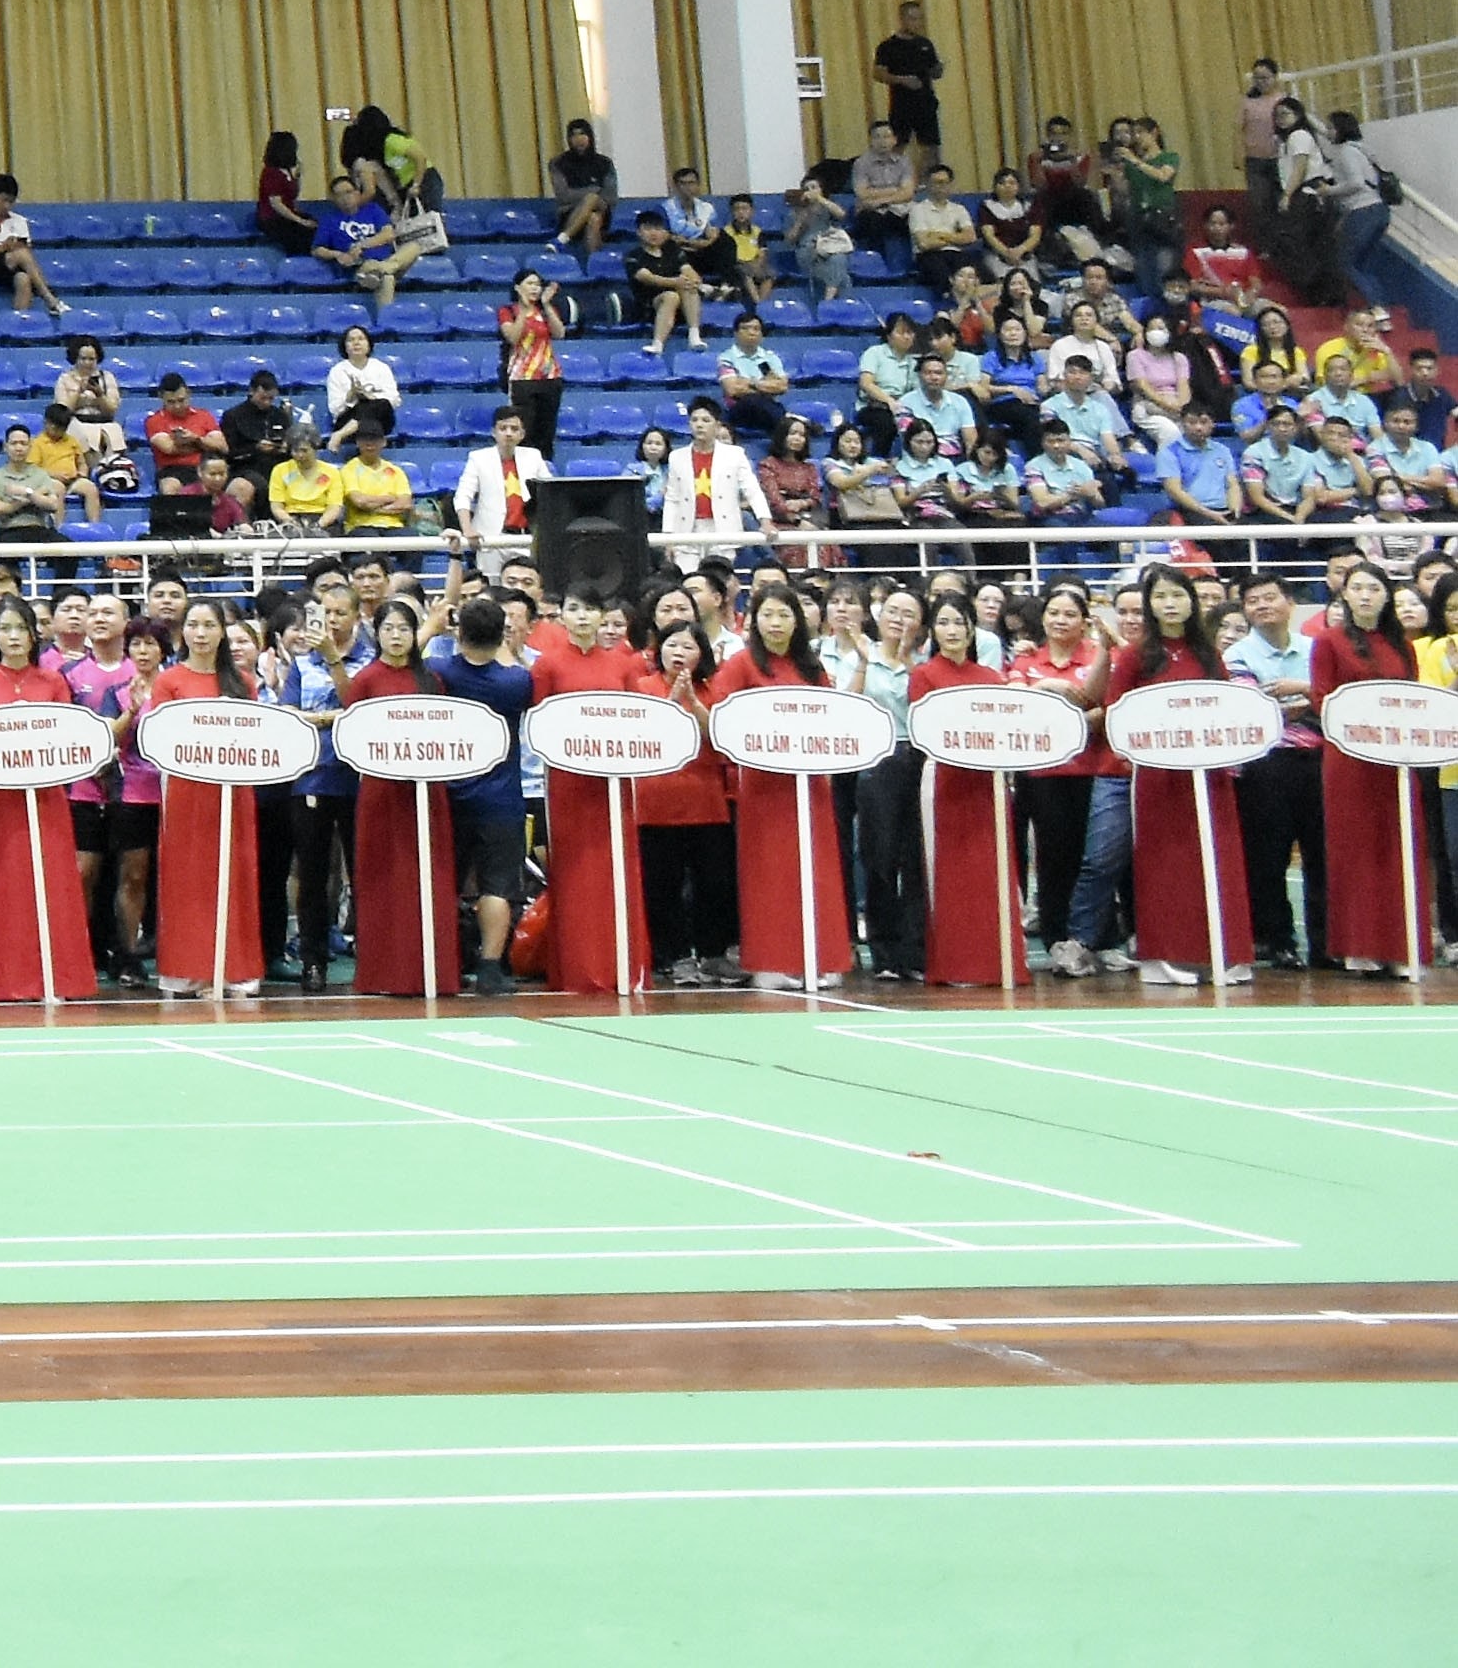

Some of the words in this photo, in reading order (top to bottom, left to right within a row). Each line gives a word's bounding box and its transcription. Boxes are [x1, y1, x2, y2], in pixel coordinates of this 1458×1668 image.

[803, 703, 827, 714] THPT
[368, 742, 389, 764] THỊ
[395, 737, 411, 761] XÃ
[417, 741, 444, 761] SƠN
[450, 738, 474, 761] TÂY
[564, 735, 601, 761] QUẬN
[606, 739, 624, 758] BA
[629, 734, 661, 759] ĐÌNH
[745, 733, 761, 752] GIA
[767, 731, 789, 754] LÂM
[802, 735, 830, 755] LONG
[835, 733, 859, 756] BIÊN
[944, 730, 959, 749] BA
[965, 726, 995, 750] ĐÌNH
[1007, 728, 1030, 752] TÂY
[1035, 726, 1051, 752] HỒ
[3, 750, 33, 769] NAM
[39, 742, 57, 766] TỪ
[61, 742, 92, 765] LIÊM
[175, 741, 213, 768] QUẬN
[219, 740, 257, 766] ĐỐNG
[261, 748, 280, 768] ĐA
